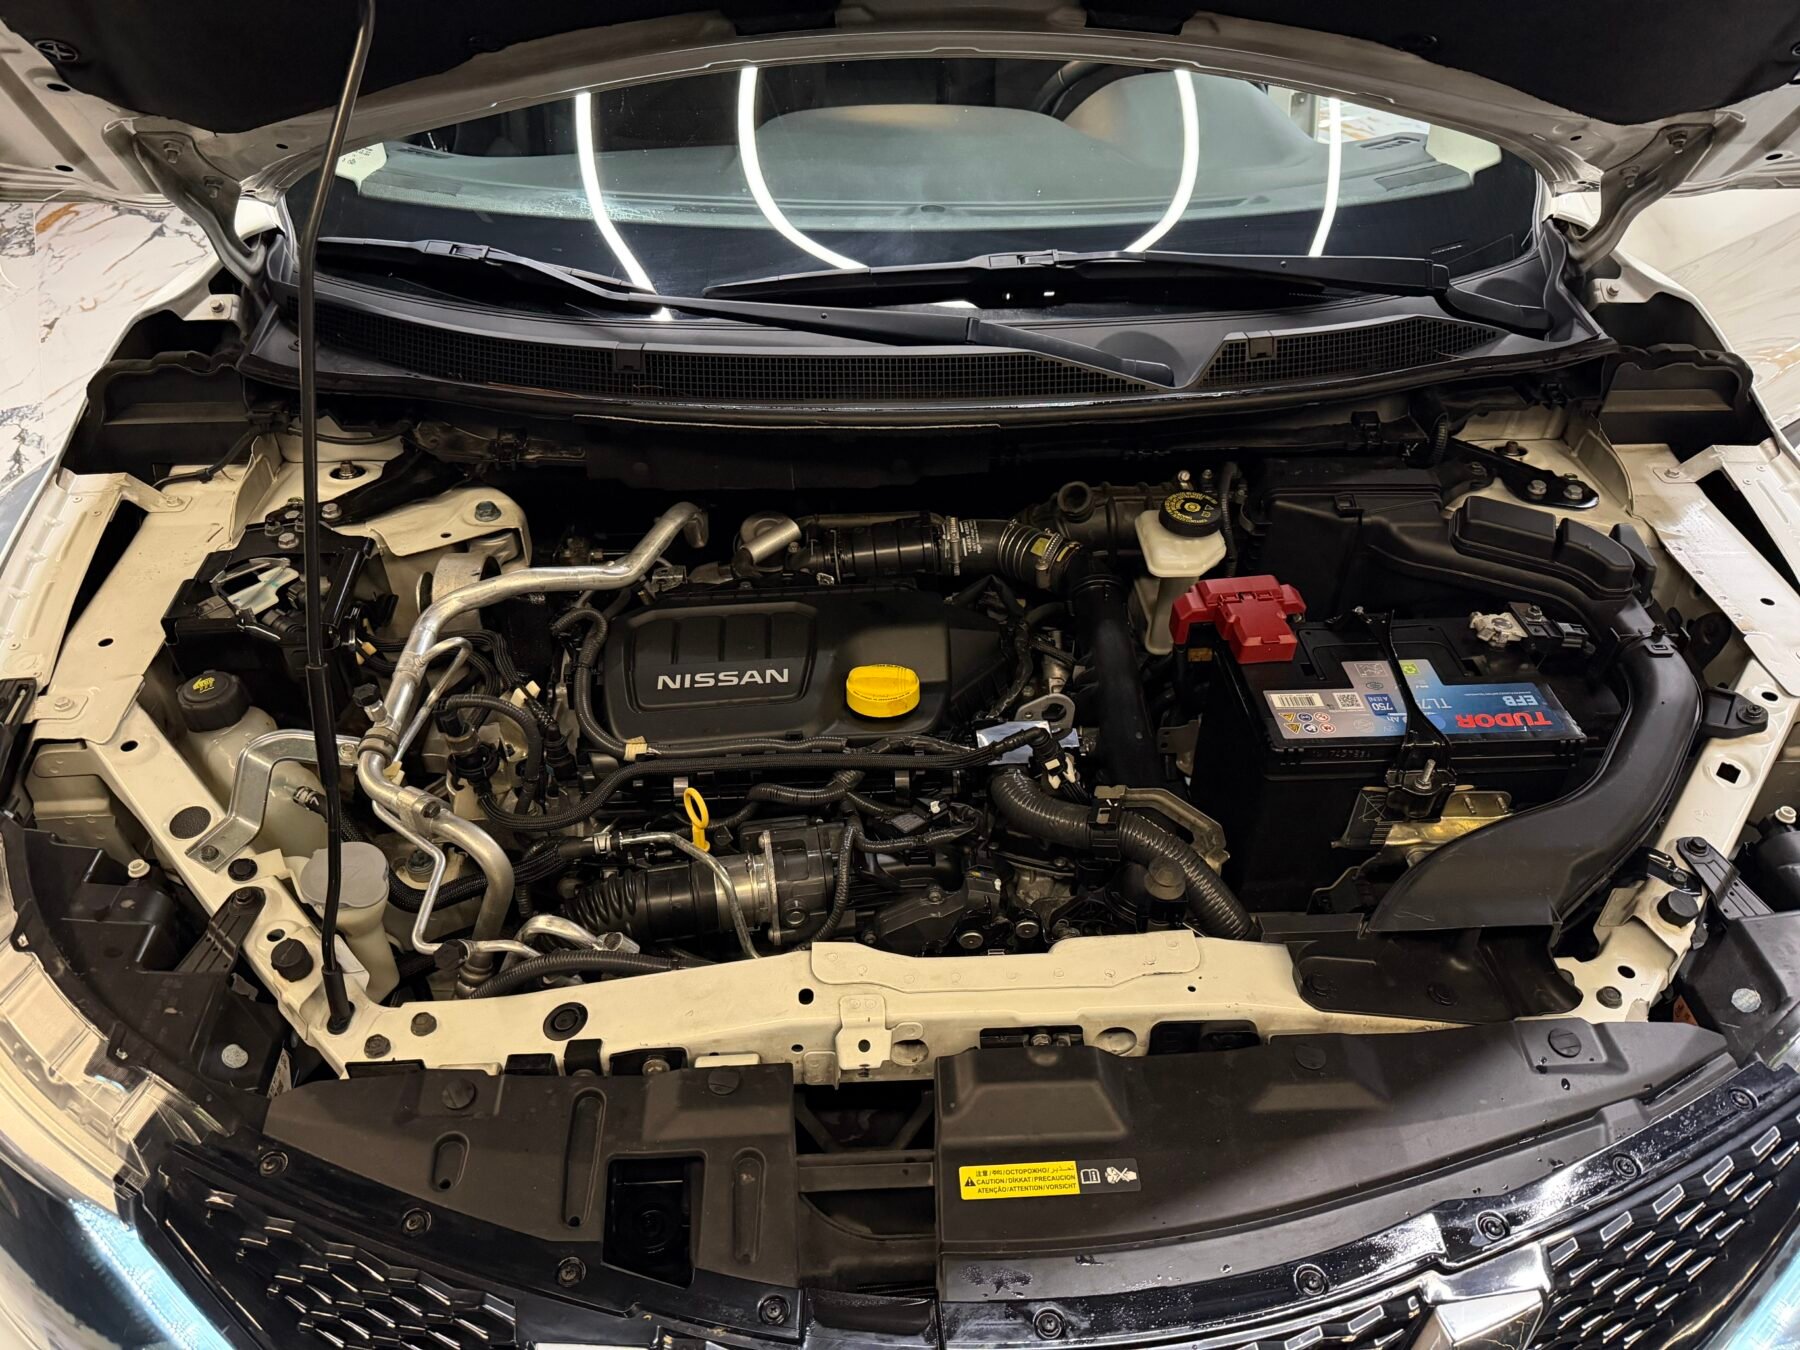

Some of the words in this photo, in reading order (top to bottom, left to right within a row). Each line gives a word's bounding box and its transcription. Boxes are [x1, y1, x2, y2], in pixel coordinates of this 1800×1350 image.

[657, 668, 789, 690] NISSAN
[1371, 702, 1394, 711] 750
[1502, 695, 1539, 707] EFB
[1455, 712, 1552, 728] TUDOR
